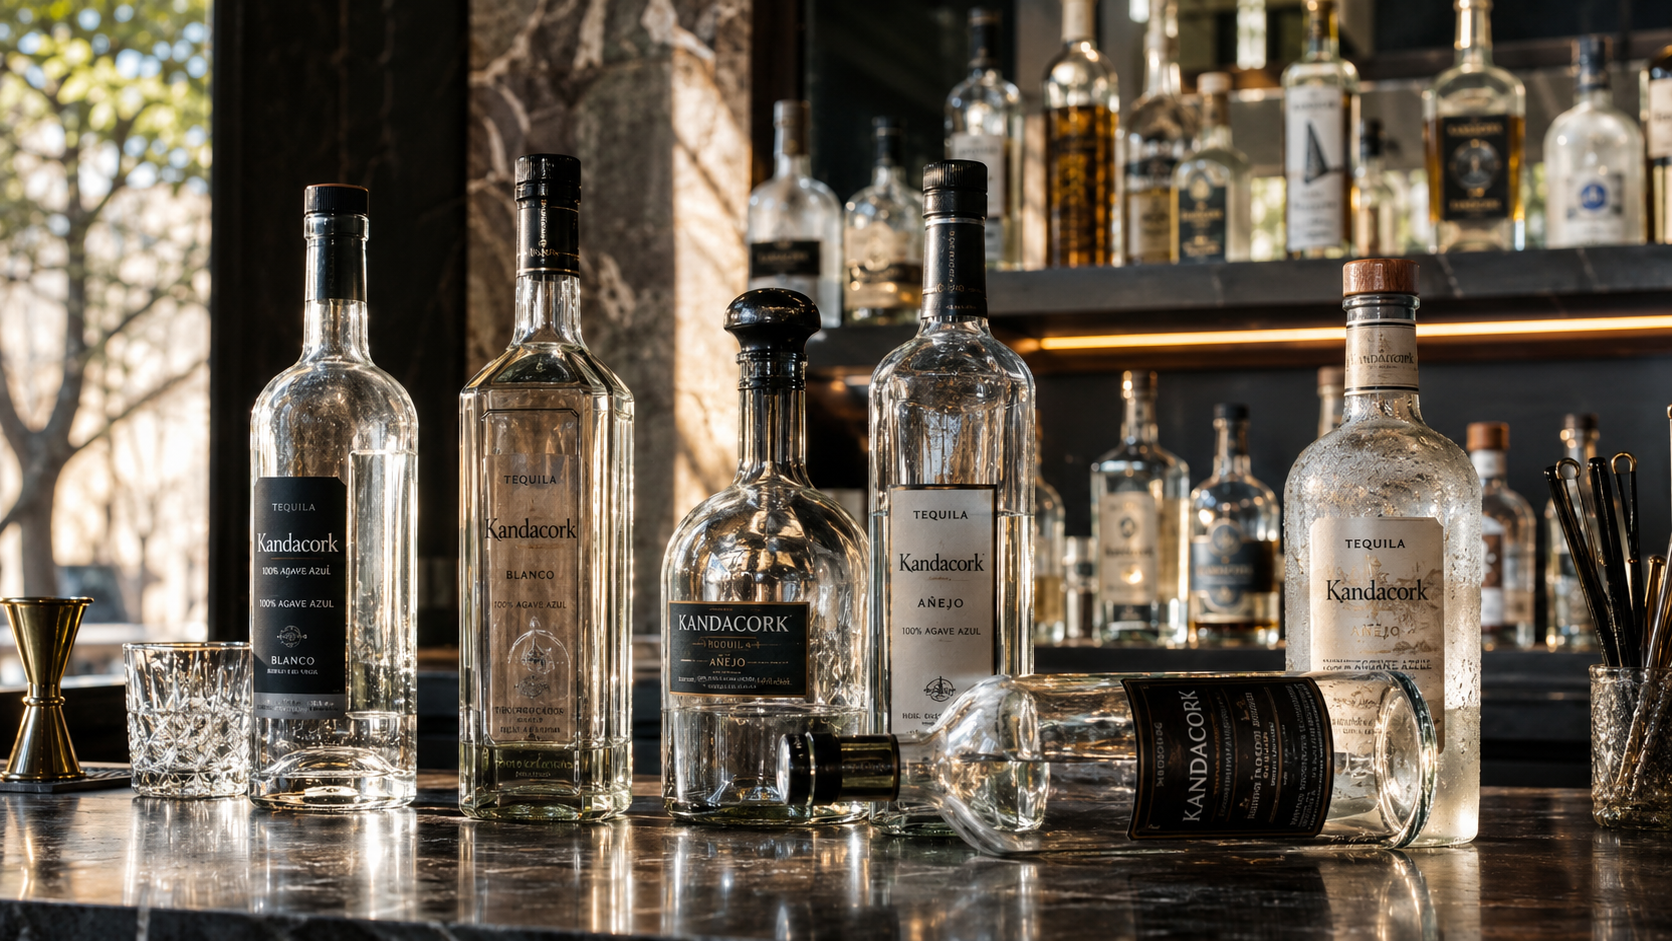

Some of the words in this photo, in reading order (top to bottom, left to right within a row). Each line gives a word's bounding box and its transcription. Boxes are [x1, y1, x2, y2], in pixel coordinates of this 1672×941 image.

[504, 475, 557, 485] TEQUILA
[272, 503, 316, 513] TEQUILA
[913, 510, 969, 521] TEQUILA
[484, 518, 577, 541] Kandacork
[257, 532, 339, 553] Kandacork
[1345, 539, 1406, 550] TEQUILA
[899, 553, 984, 573] Kandacork
[506, 570, 554, 580] BLANCO
[1326, 579, 1429, 603] Kandacork
[278, 599, 307, 608] AGAVE
[309, 599, 334, 608] AZUL
[516, 601, 544, 609] AGAVE
[546, 601, 567, 609] AZUL
[917, 596, 964, 610] AÑEJO
[678, 614, 789, 632] KANDACORK
[902, 627, 922, 635] 100%
[924, 627, 955, 635] AGAVE
[957, 627, 981, 635] AZUL
[271, 655, 315, 665] BLANCO
[1178, 690, 1208, 822] KANDACORK
